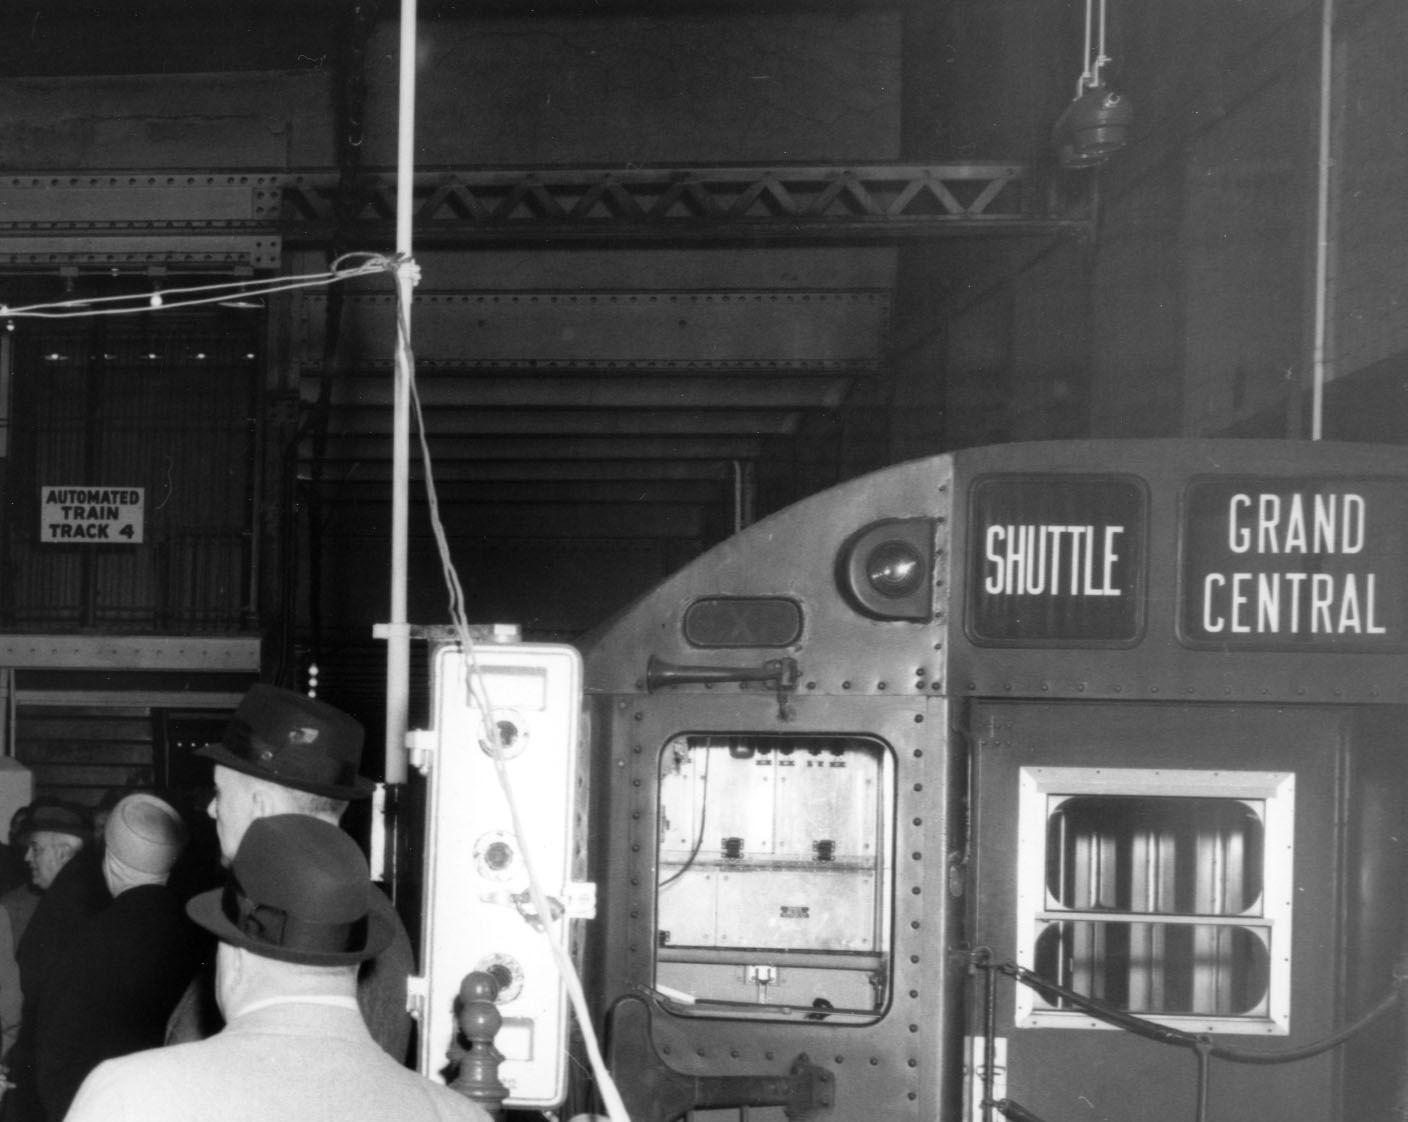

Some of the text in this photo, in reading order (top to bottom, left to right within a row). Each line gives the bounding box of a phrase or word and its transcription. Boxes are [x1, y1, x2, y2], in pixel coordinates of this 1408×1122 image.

[46, 489, 140, 505] AUTOMATED
[61, 506, 119, 520] TRAIN
[49, 523, 134, 539] TRACK 4
[1229, 493, 1366, 554] GRAND
[985, 525, 1124, 596] SHUTTLE
[1203, 572, 1387, 634] CENTRAL
